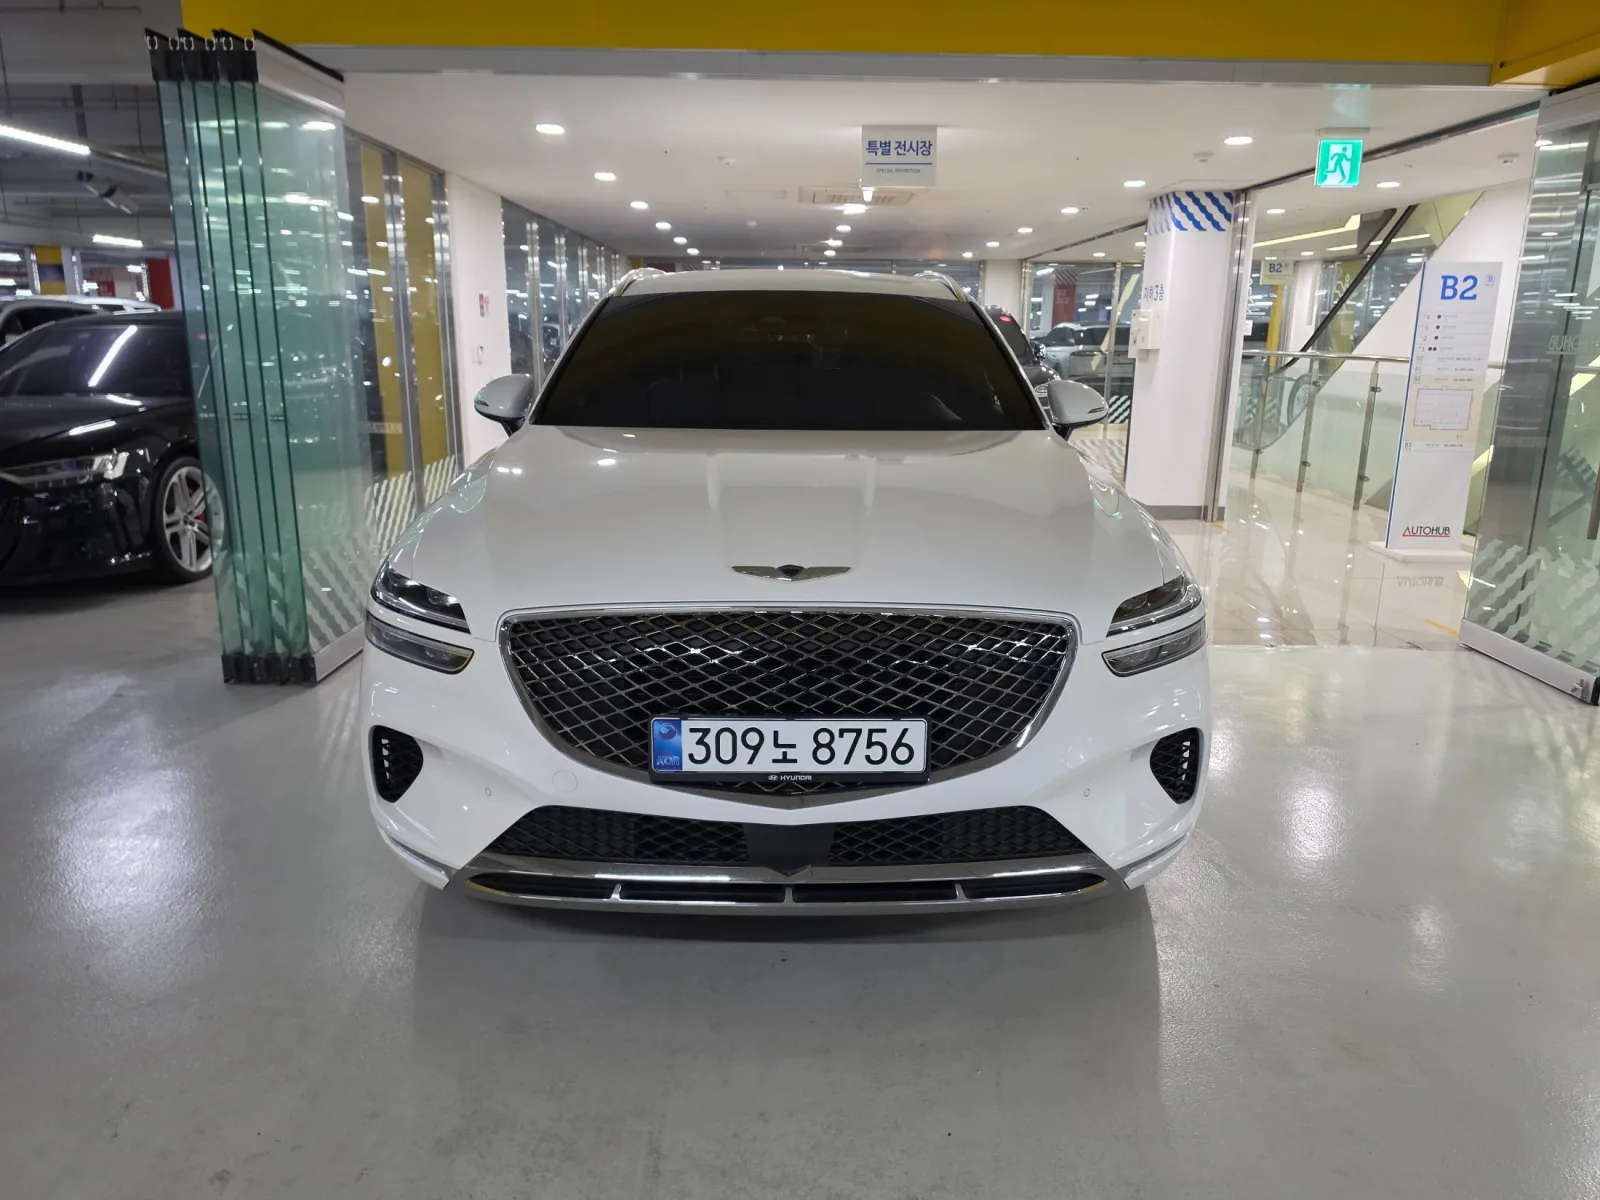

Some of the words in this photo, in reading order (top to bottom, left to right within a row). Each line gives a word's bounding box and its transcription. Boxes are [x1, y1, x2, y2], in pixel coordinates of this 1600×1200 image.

[866, 140, 891, 156] 특별
[894, 140, 933, 156] 전시장
[1269, 263, 1283, 273] B2
[1440, 275, 1478, 300] B2
[1402, 526, 1451, 537] AUTOHUB
[688, 727, 798, 765] 309노
[812, 727, 915, 765] 8756
[656, 755, 680, 766] KOR
